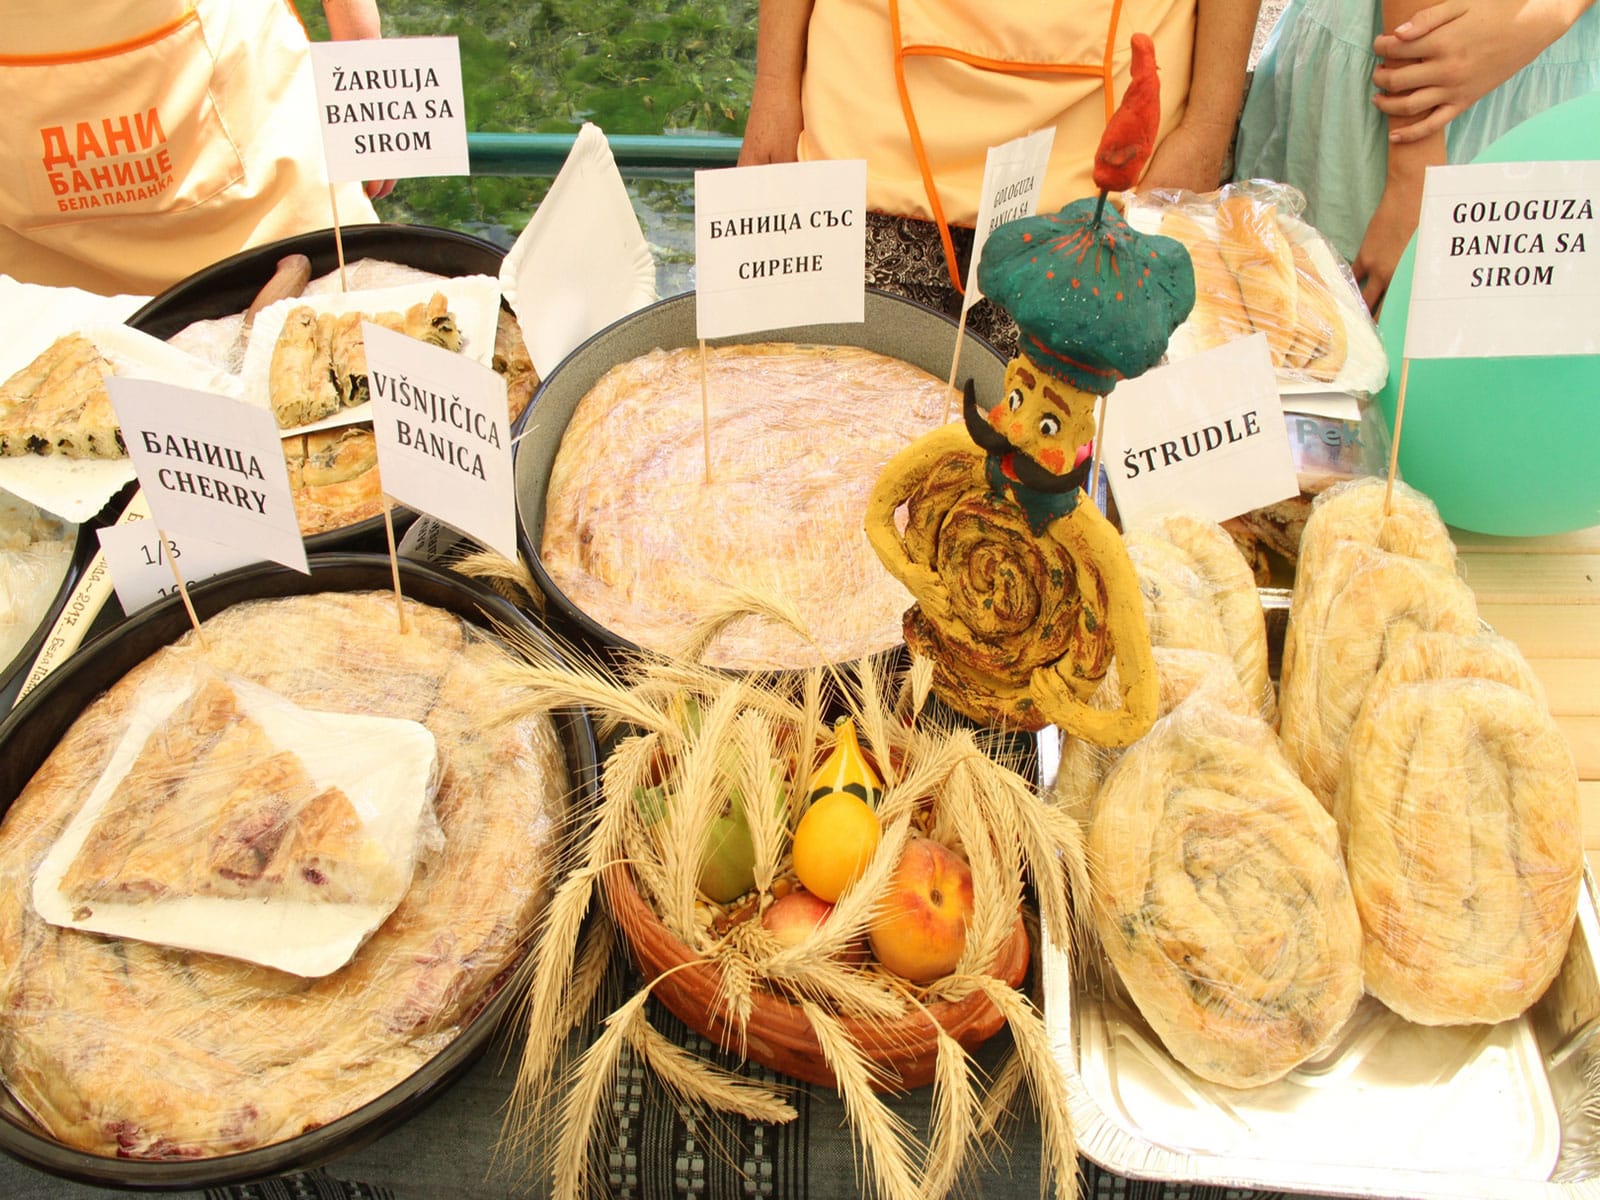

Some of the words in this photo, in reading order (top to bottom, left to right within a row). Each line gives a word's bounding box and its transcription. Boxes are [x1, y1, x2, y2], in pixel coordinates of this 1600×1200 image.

[333, 66, 440, 93] ŽARULJA
[326, 100, 417, 124] BANICA
[424, 99, 454, 119] SA
[40, 107, 167, 171] ДАНИ
[354, 131, 432, 154] SIROM
[48, 149, 172, 196] БАНИЦЕ
[57, 195, 101, 212] БЕЛА
[993, 175, 1035, 208] GOLOGUZA
[710, 212, 802, 239] БАНИЦА
[810, 209, 853, 228] СЪС
[1453, 199, 1593, 224] GOLOGUZA
[1450, 233, 1545, 256] BANICA
[1555, 233, 1586, 253] SA
[738, 255, 823, 280] СИРЕНЕ
[1471, 266, 1555, 287] SIROM
[372, 371, 501, 450] VIŠNJIČICA
[140, 430, 266, 480] БАНИЦА
[396, 419, 488, 481] BANICA
[1123, 411, 1261, 480] ŠTRUDLE
[158, 468, 267, 515] CHERRY
[141, 540, 181, 565] 1/3
